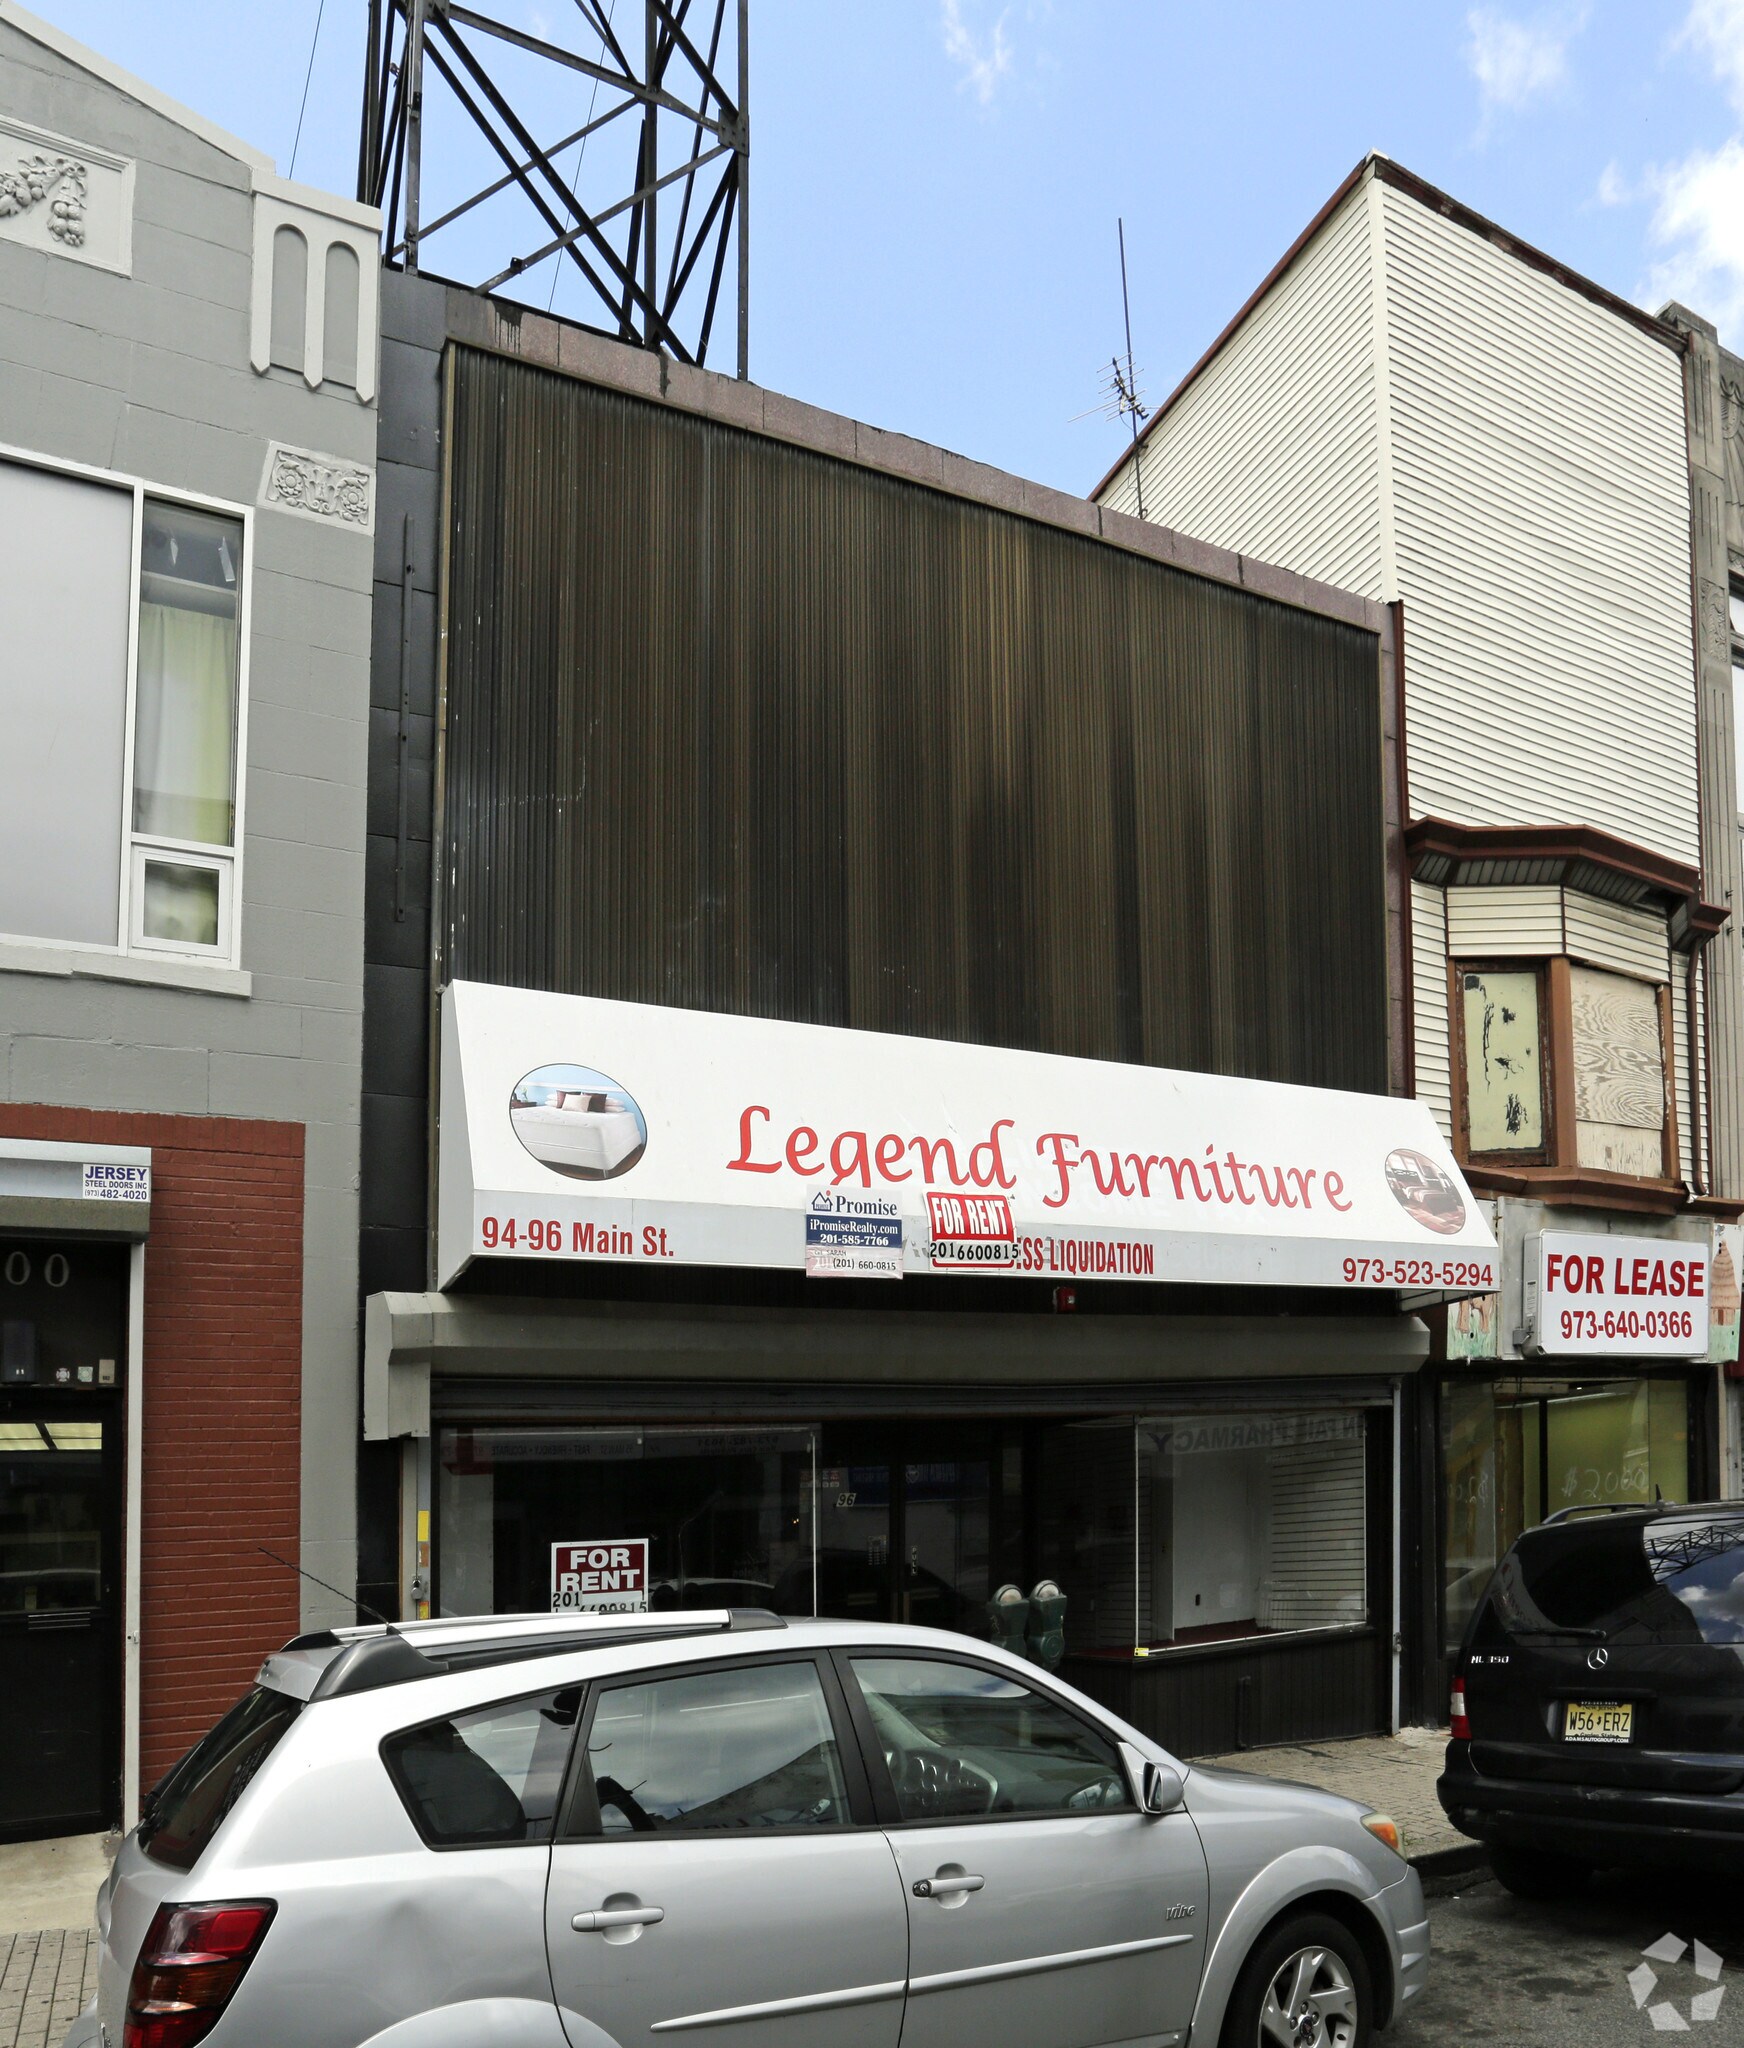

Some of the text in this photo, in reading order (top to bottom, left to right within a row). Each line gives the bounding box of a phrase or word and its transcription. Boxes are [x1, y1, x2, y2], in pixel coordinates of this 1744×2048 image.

[726, 1105, 1017, 1188] Legend
[1035, 1132, 1354, 1212] Furniture
[85, 1166, 147, 1181] JERSEY
[85, 1180, 147, 1190] STEEL DOORS INC
[810, 1219, 898, 1235] iPromiseRealty.com
[931, 1197, 965, 1235] FOR
[965, 1199, 1008, 1235] RENT
[482, 1216, 674, 1257] 94-96 Main St.
[820, 1233, 889, 1246] 201-585-7766
[833, 1257, 896, 1271] (201) 660-0815
[1050, 1239, 1154, 1275] LIQUIDATION
[1342, 1257, 1493, 1287] 973-523-5294
[1547, 1253, 1704, 1297] FOR LEASE
[1560, 1310, 1692, 1339] 973-640-0366
[838, 1494, 855, 1506] 96
[570, 1548, 630, 1570] FOR
[560, 1569, 640, 1592] RENT
[552, 1592, 580, 1608] 201
[1569, 1712, 1630, 1732] W56 ERZ
